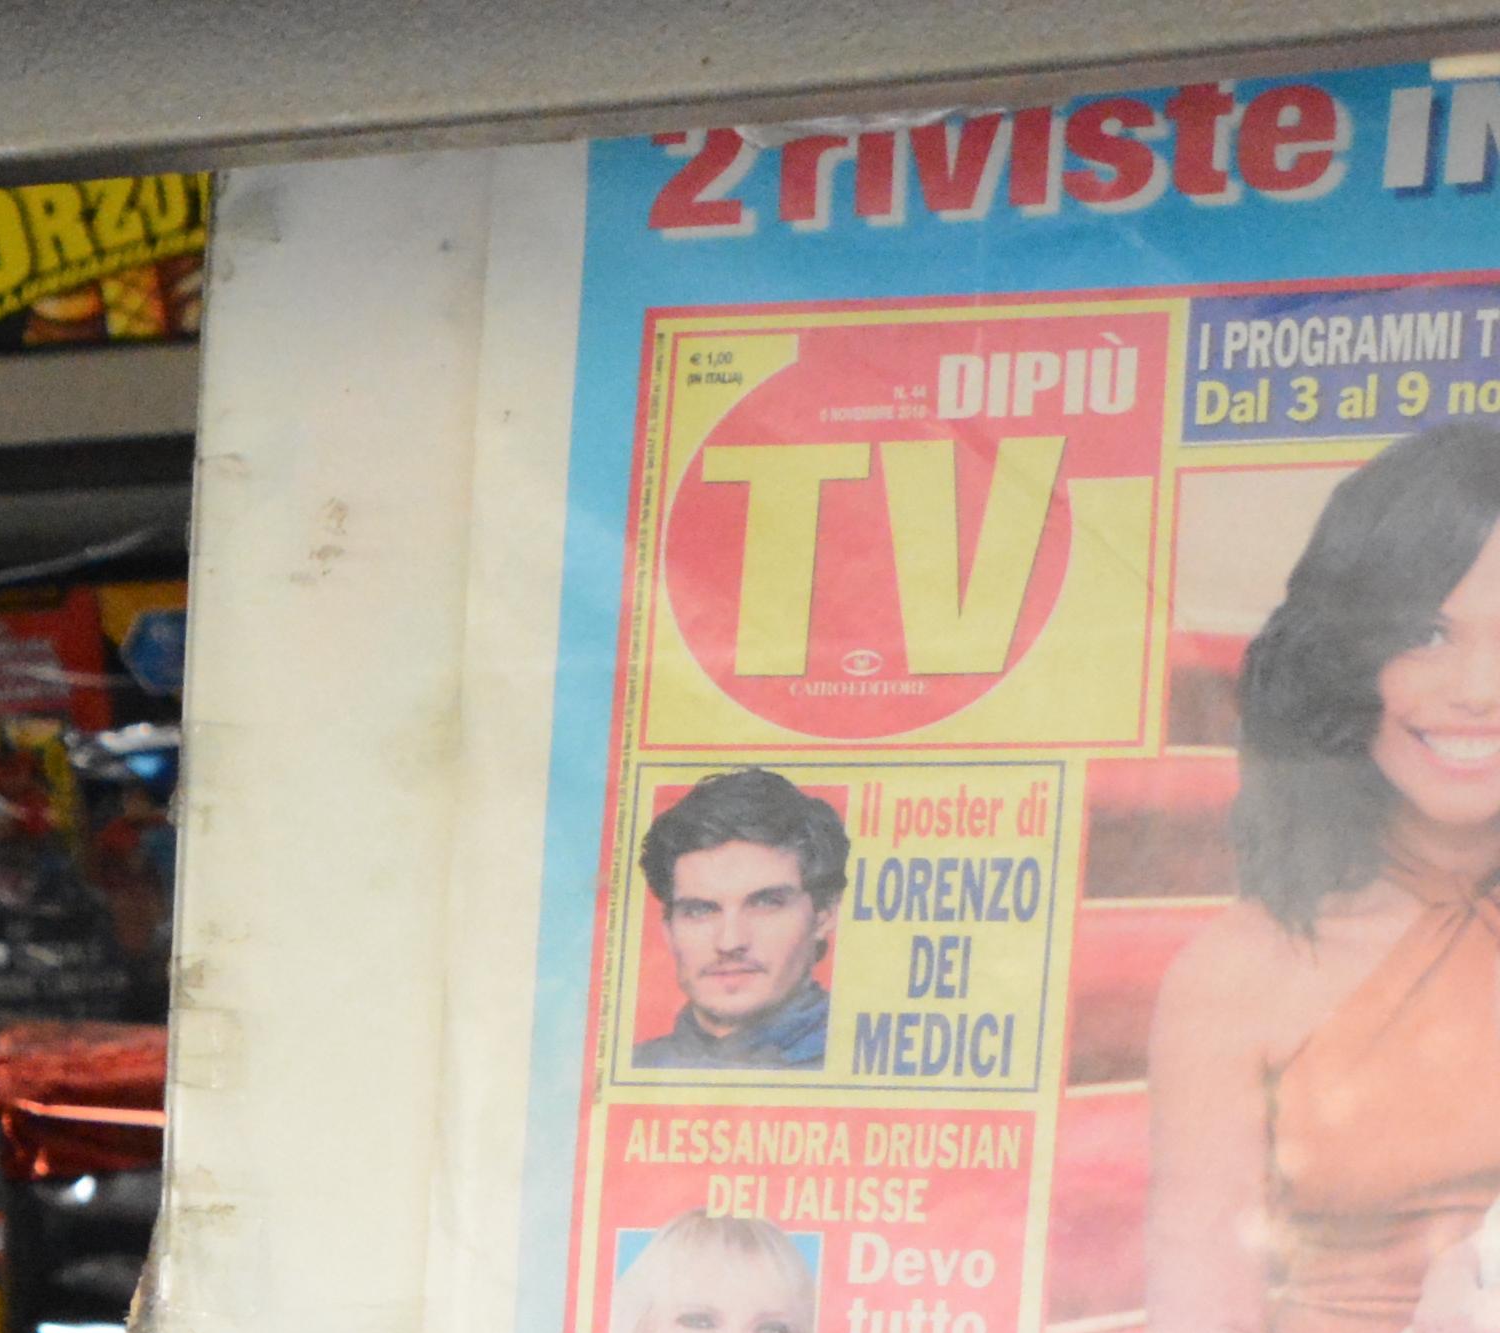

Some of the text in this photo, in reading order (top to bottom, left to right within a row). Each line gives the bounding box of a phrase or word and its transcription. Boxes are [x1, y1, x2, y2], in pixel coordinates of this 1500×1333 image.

[935, 331, 1137, 421] DIPIÙ
[1193, 368, 1431, 427] Dal 3 al 9
[702, 434, 1068, 679] TV
[858, 782, 1048, 848] Il poster di
[852, 856, 1041, 923] LORENZO
[907, 935, 971, 1001] DEI
[850, 1013, 1014, 1079] MEDICI
[624, 1118, 1022, 1172] ALESSANDRA DRUSIAN
[706, 1174, 929, 1224] DEI JALISSE
[845, 1232, 997, 1290] Devo
